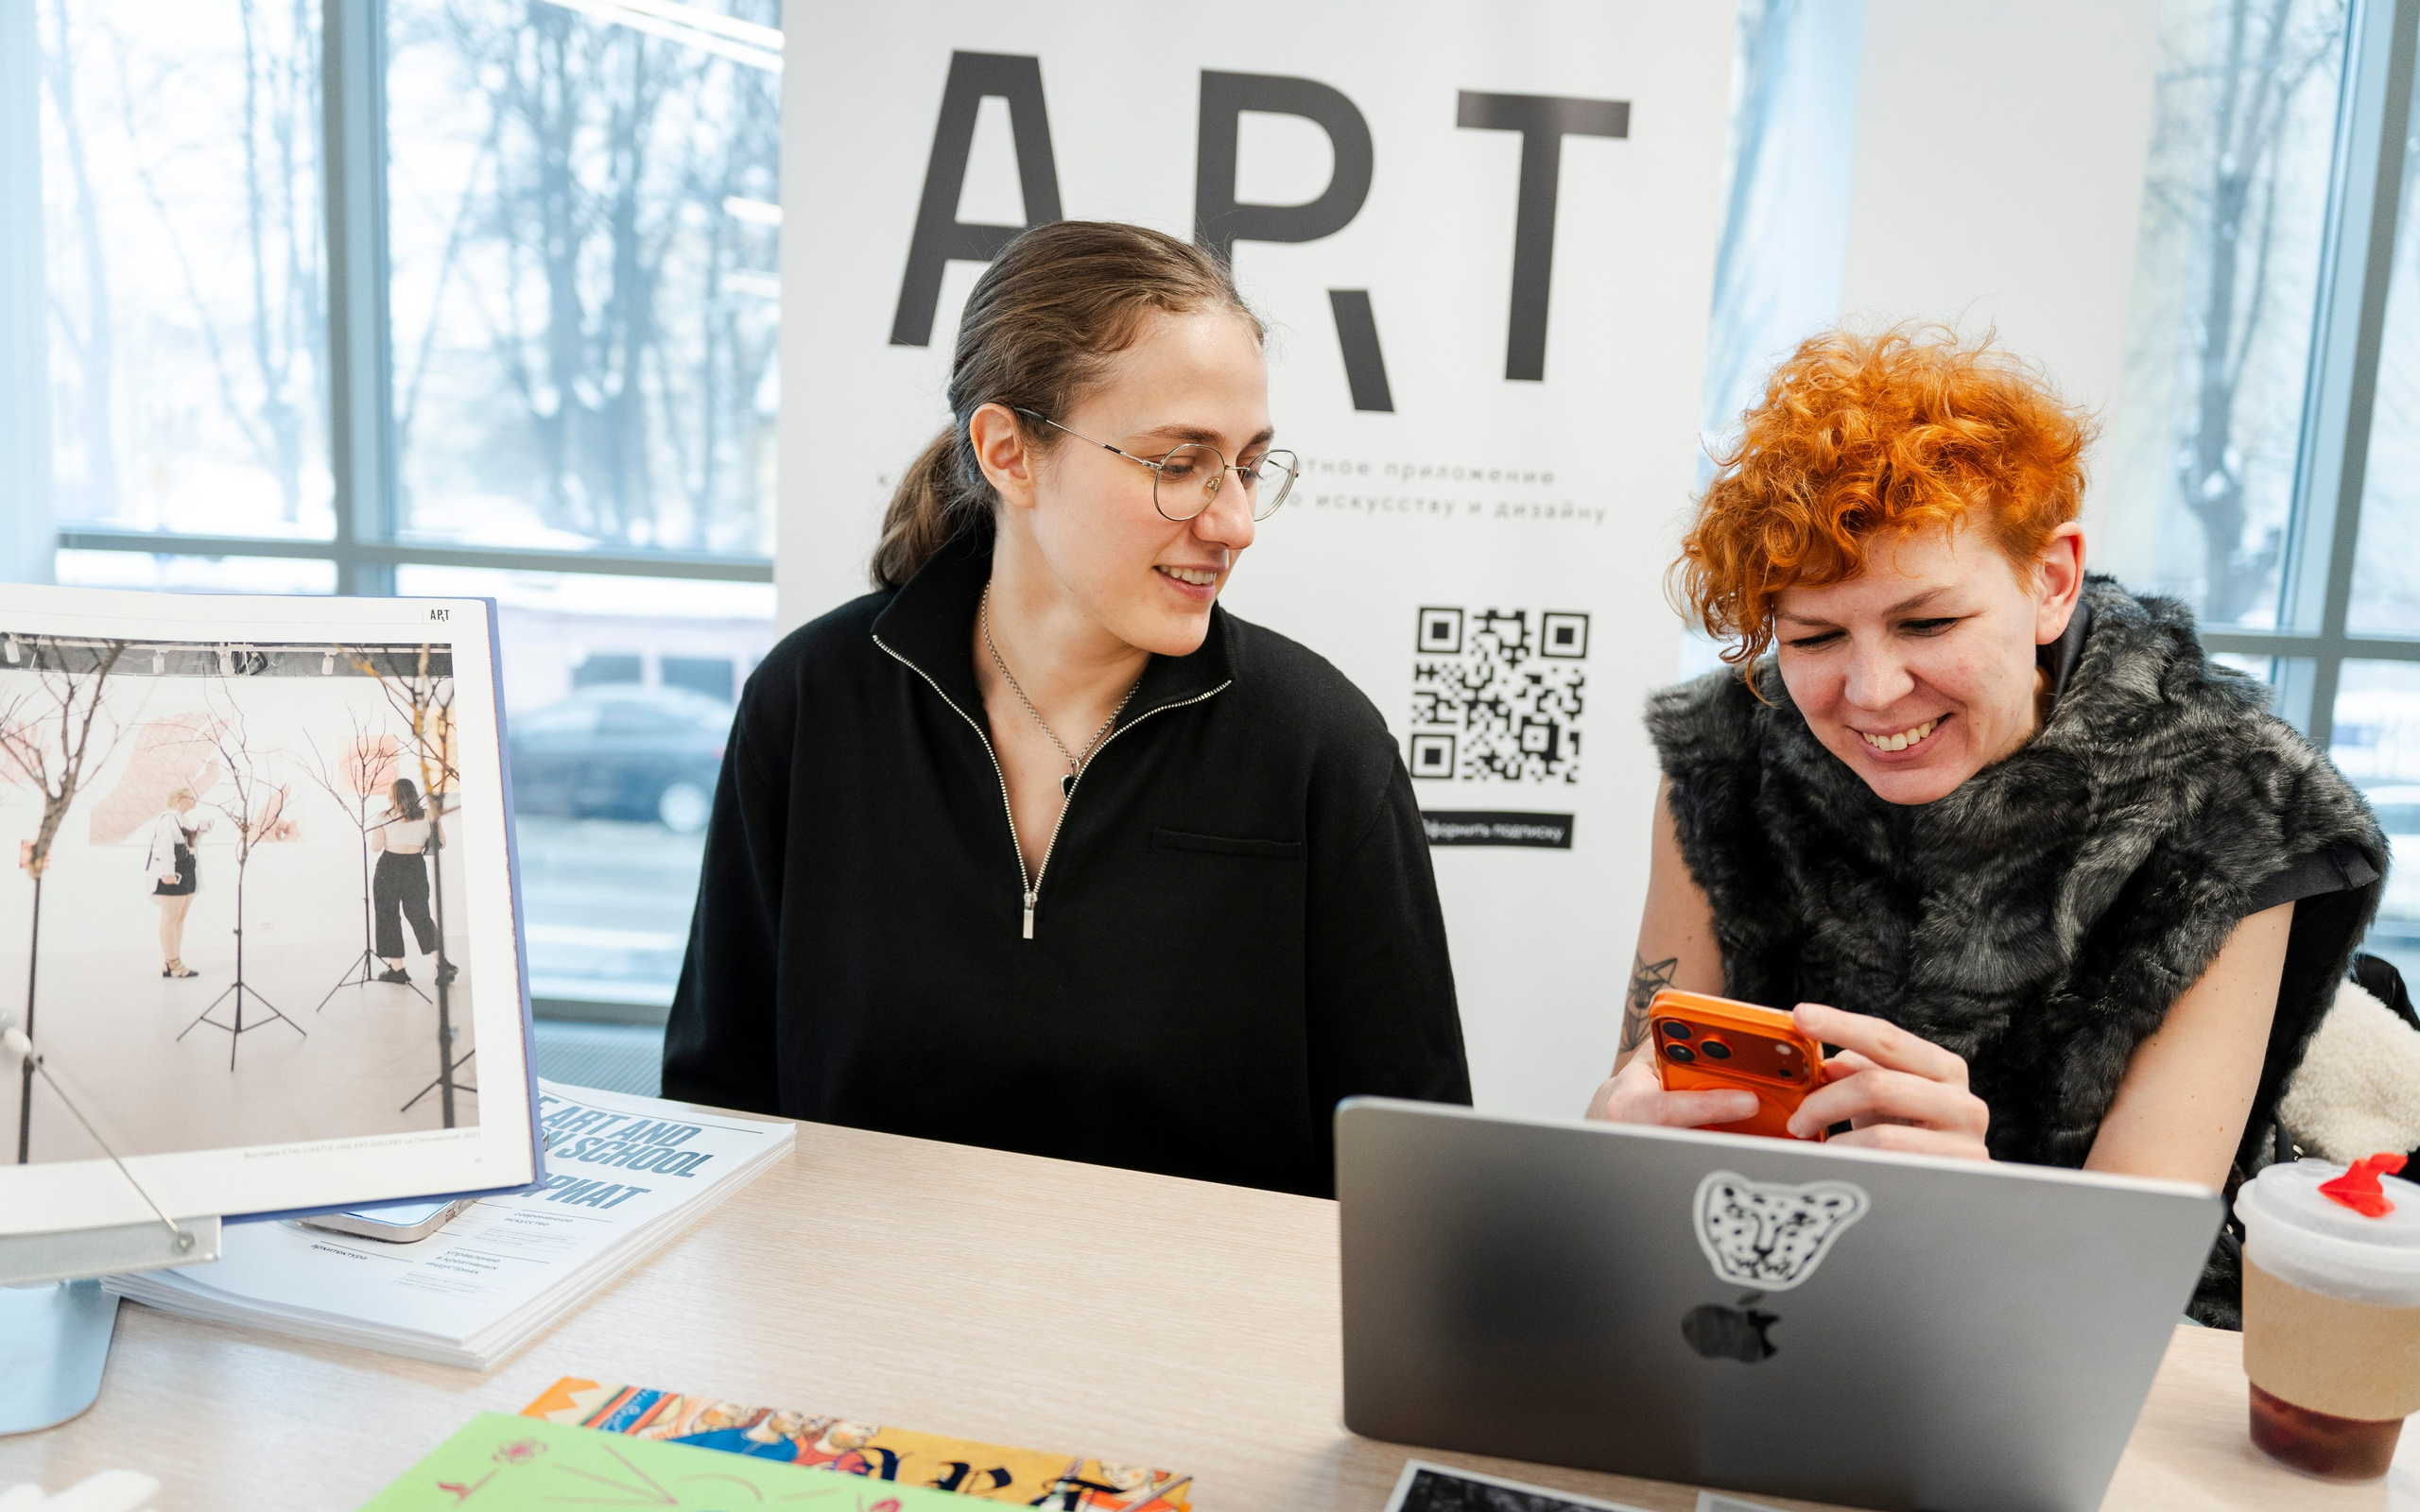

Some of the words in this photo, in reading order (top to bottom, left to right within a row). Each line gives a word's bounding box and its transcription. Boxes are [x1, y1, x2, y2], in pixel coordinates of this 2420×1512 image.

[890, 50, 1631, 413] ART
[1296, 457, 1371, 477] тное
[1384, 462, 1556, 485] приложение
[1315, 491, 1457, 518] искусству
[1468, 502, 1482, 516] и
[1494, 499, 1608, 525] дизайну
[430, 610, 450, 622] ART
[541, 1106, 631, 1136] ART
[605, 1120, 702, 1147] AND
[554, 1137, 715, 1178] SCHOOL
[521, 1172, 652, 1210] РИАТ
[505, 1217, 550, 1228] искусство
[514, 1211, 574, 1224] современное
[311, 1244, 368, 1261] архитектура
[445, 1250, 501, 1263] управление
